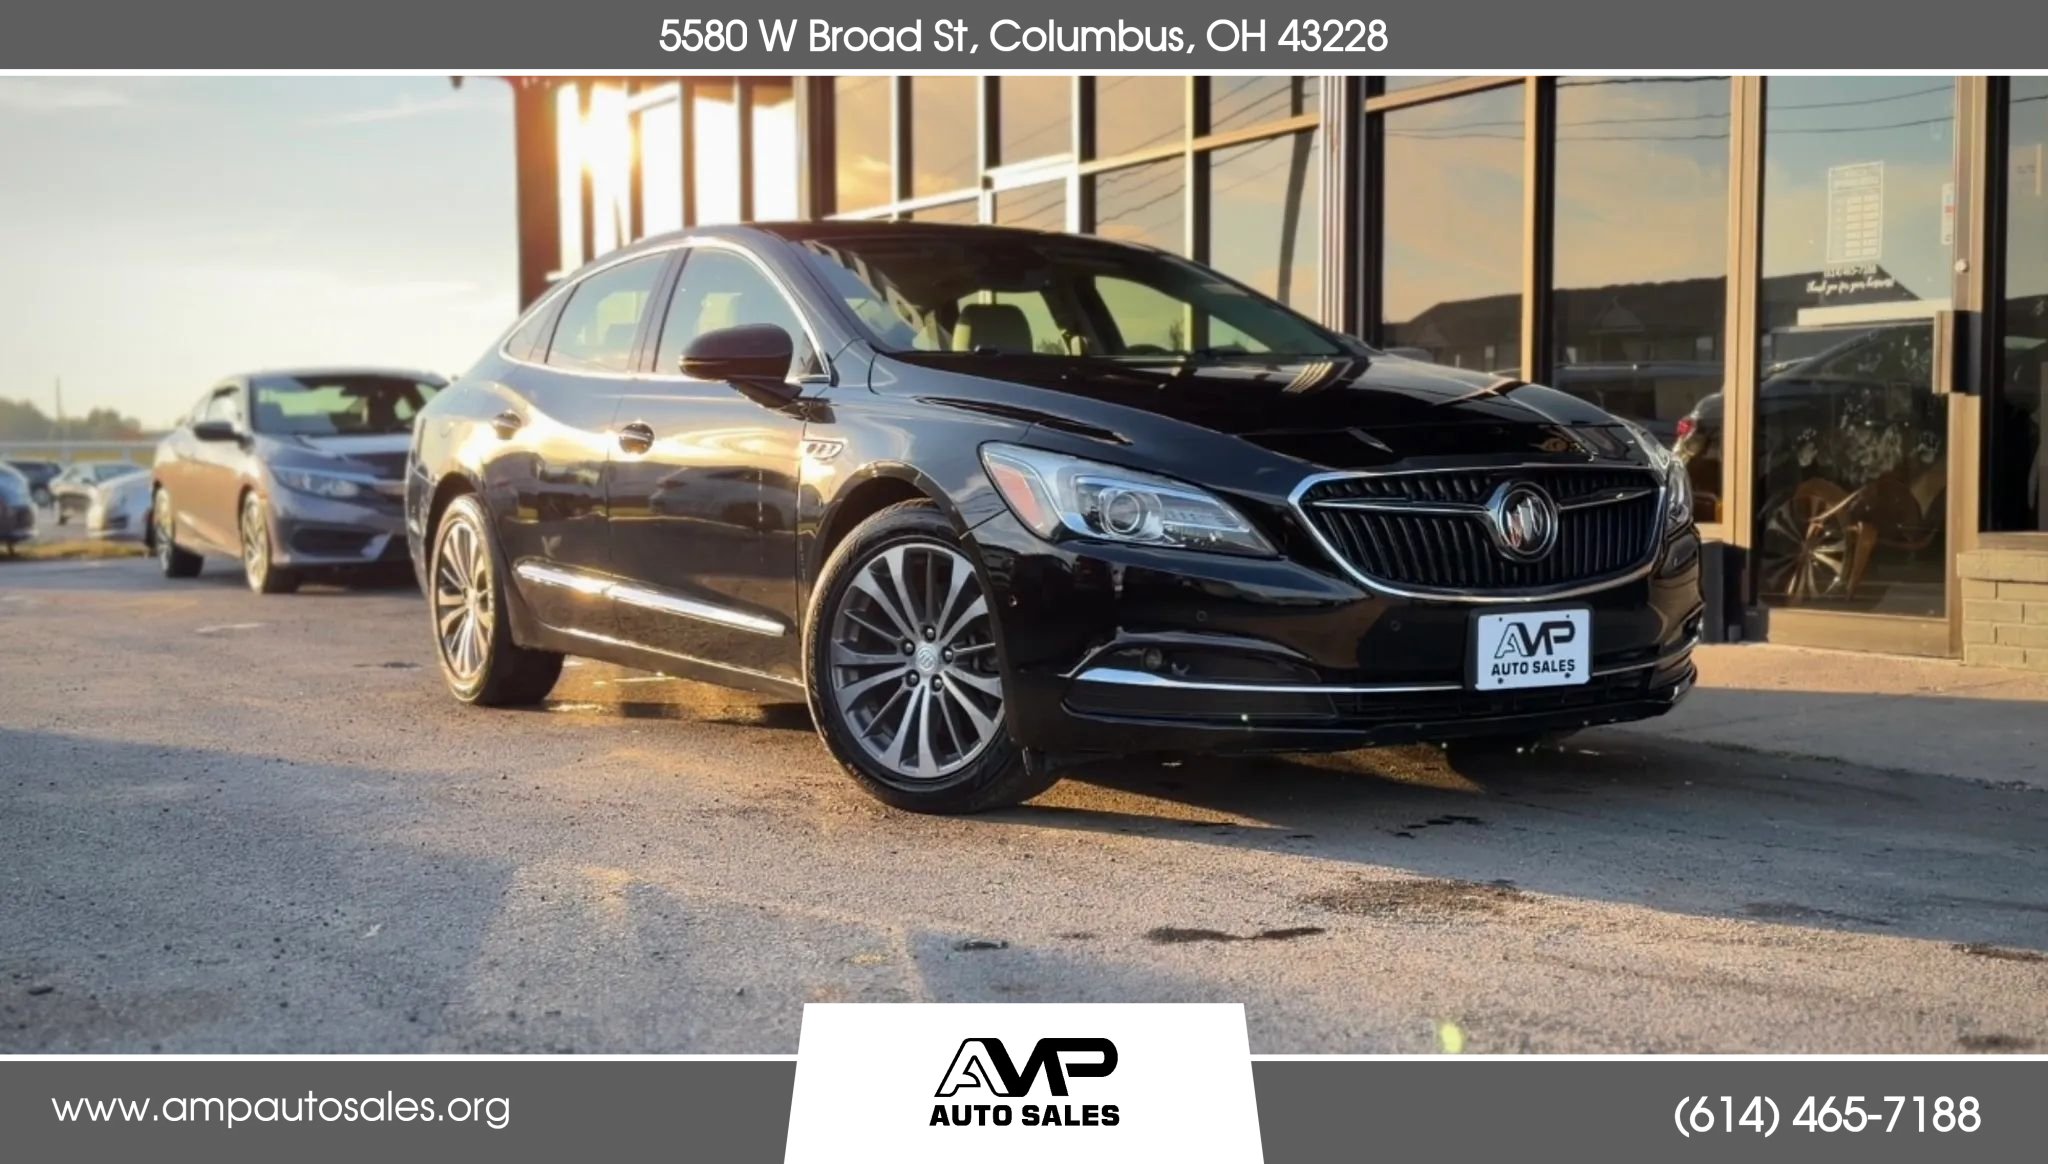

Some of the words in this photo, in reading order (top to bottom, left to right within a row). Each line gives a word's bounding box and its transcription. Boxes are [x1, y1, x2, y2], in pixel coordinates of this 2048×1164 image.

[1494, 621, 1575, 659] AMP
[1491, 661, 1529, 676] AUTO
[1532, 659, 1575, 673] SALES
